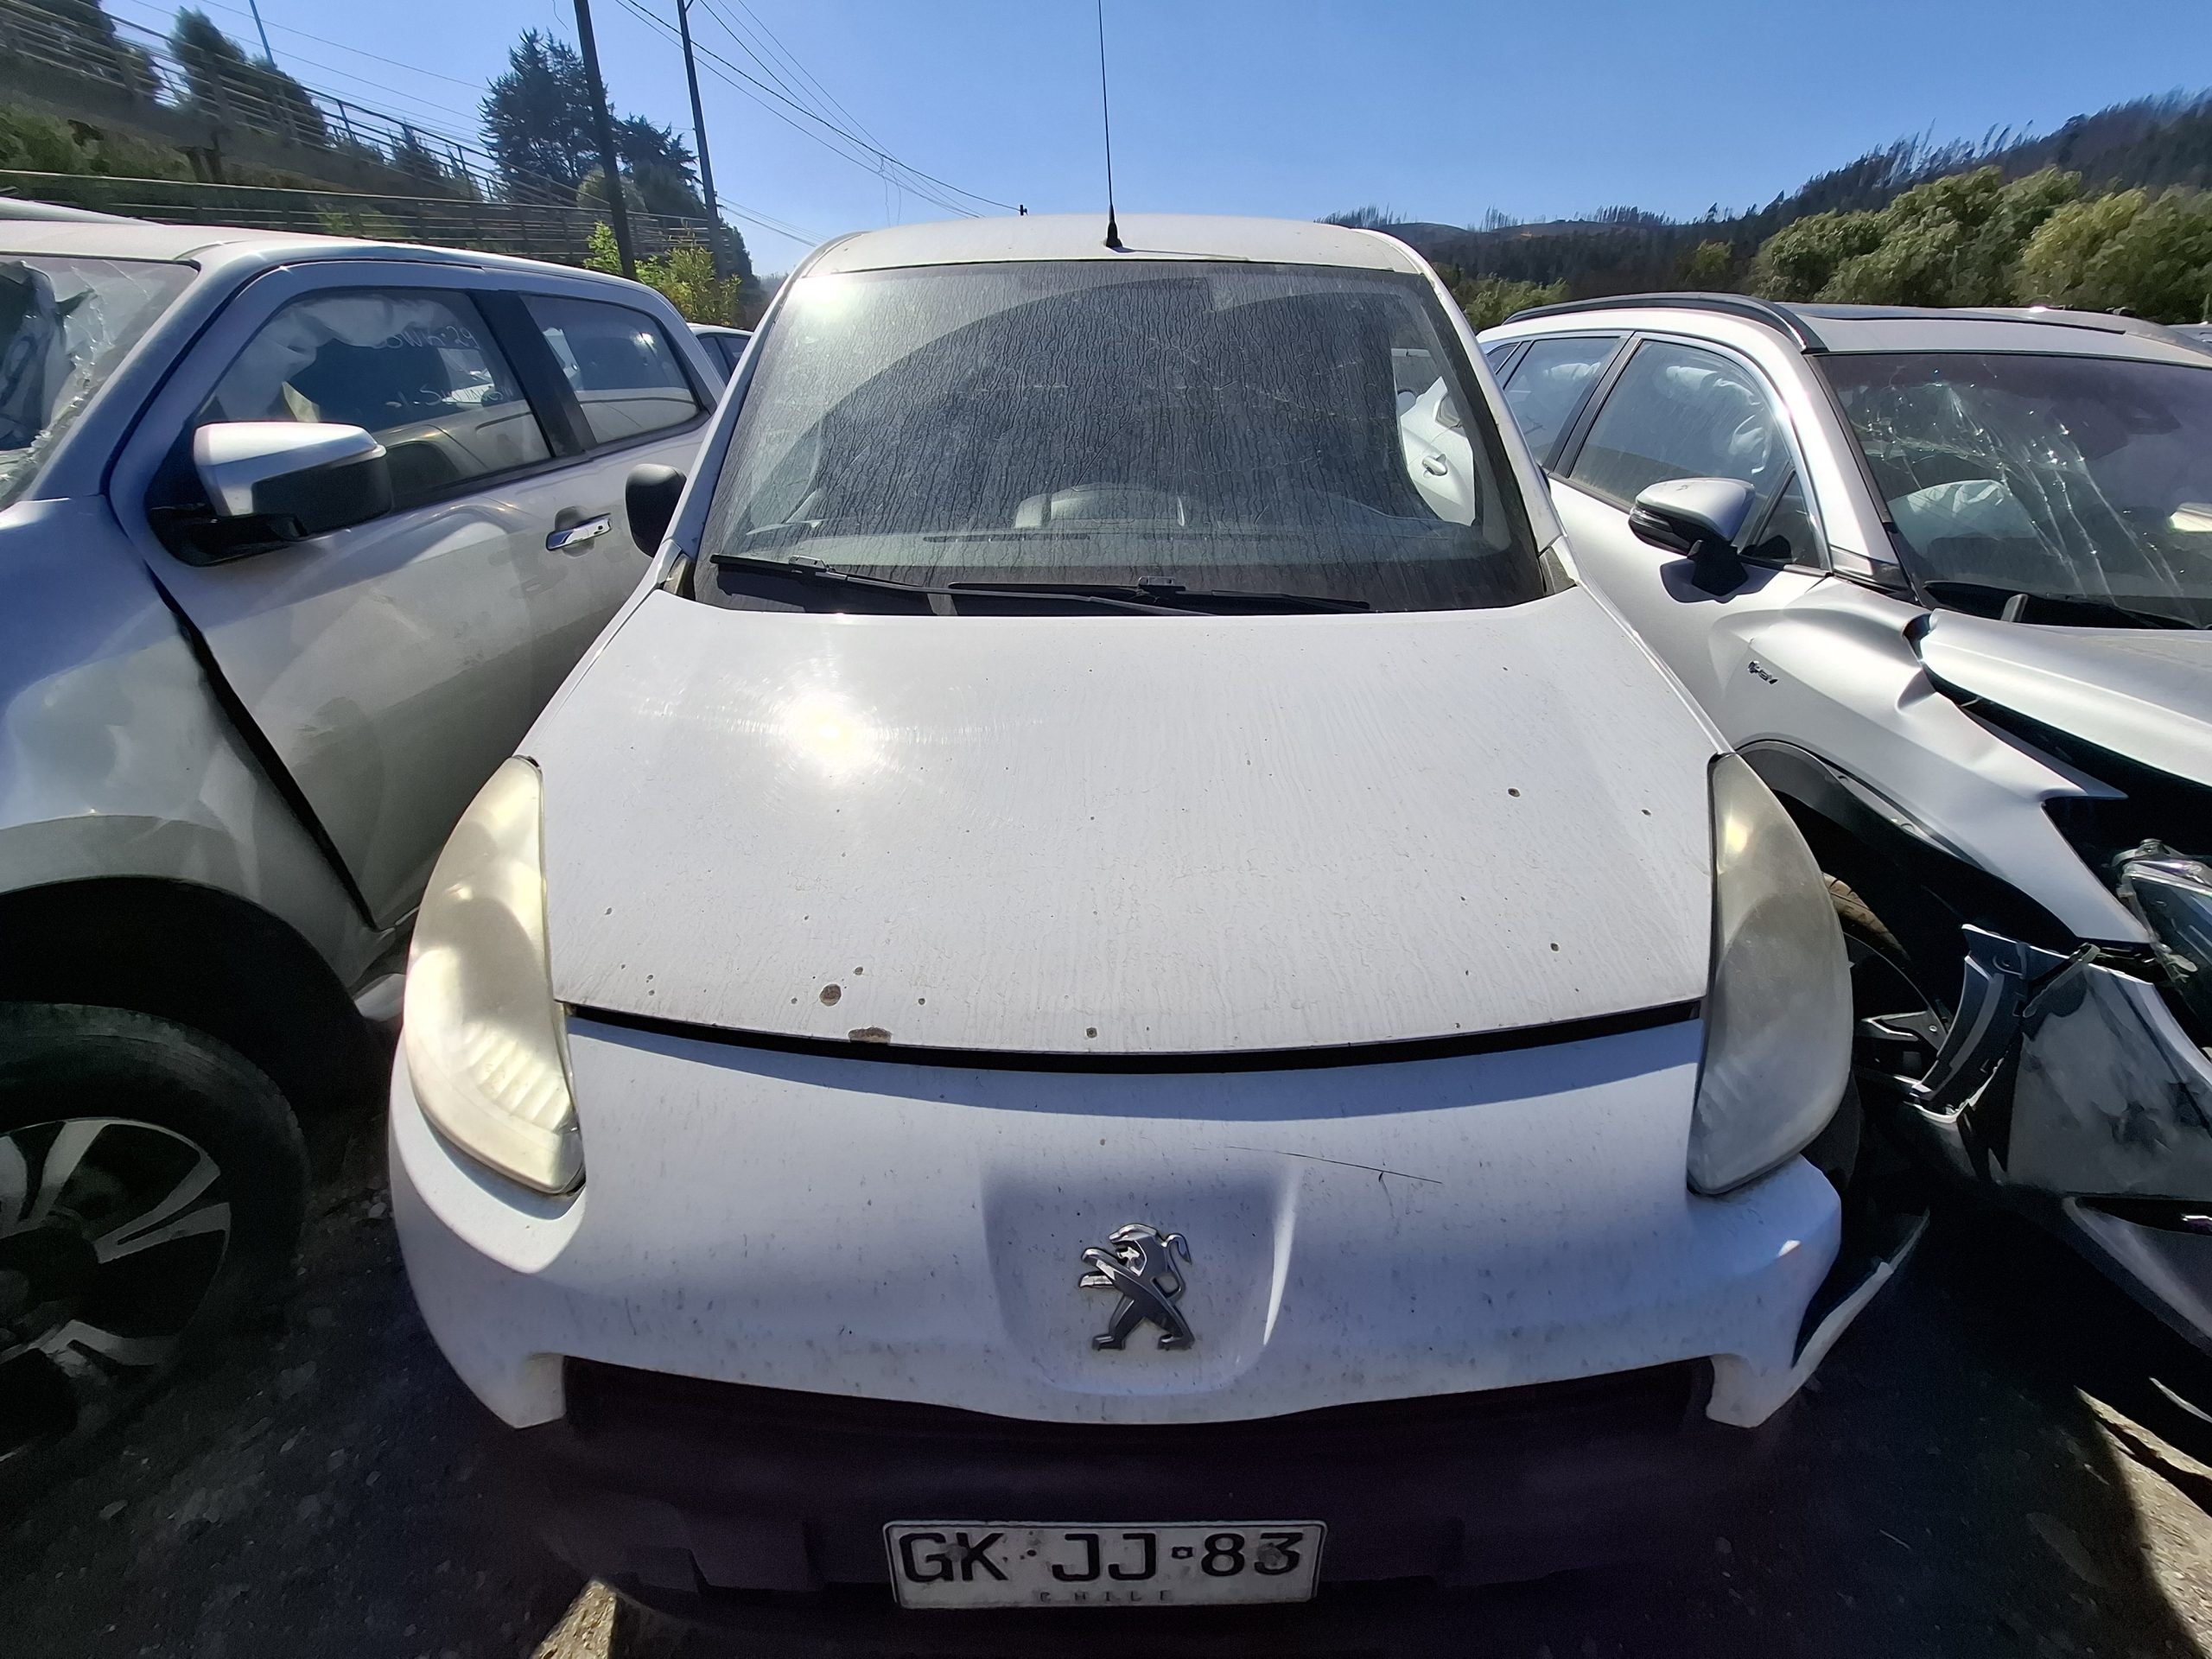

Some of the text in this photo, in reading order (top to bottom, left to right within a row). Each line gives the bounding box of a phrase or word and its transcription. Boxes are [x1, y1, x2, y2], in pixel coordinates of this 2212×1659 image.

[898, 1531, 1304, 1583] GK JJ 83
[1039, 1590, 1174, 1603] CHILE
